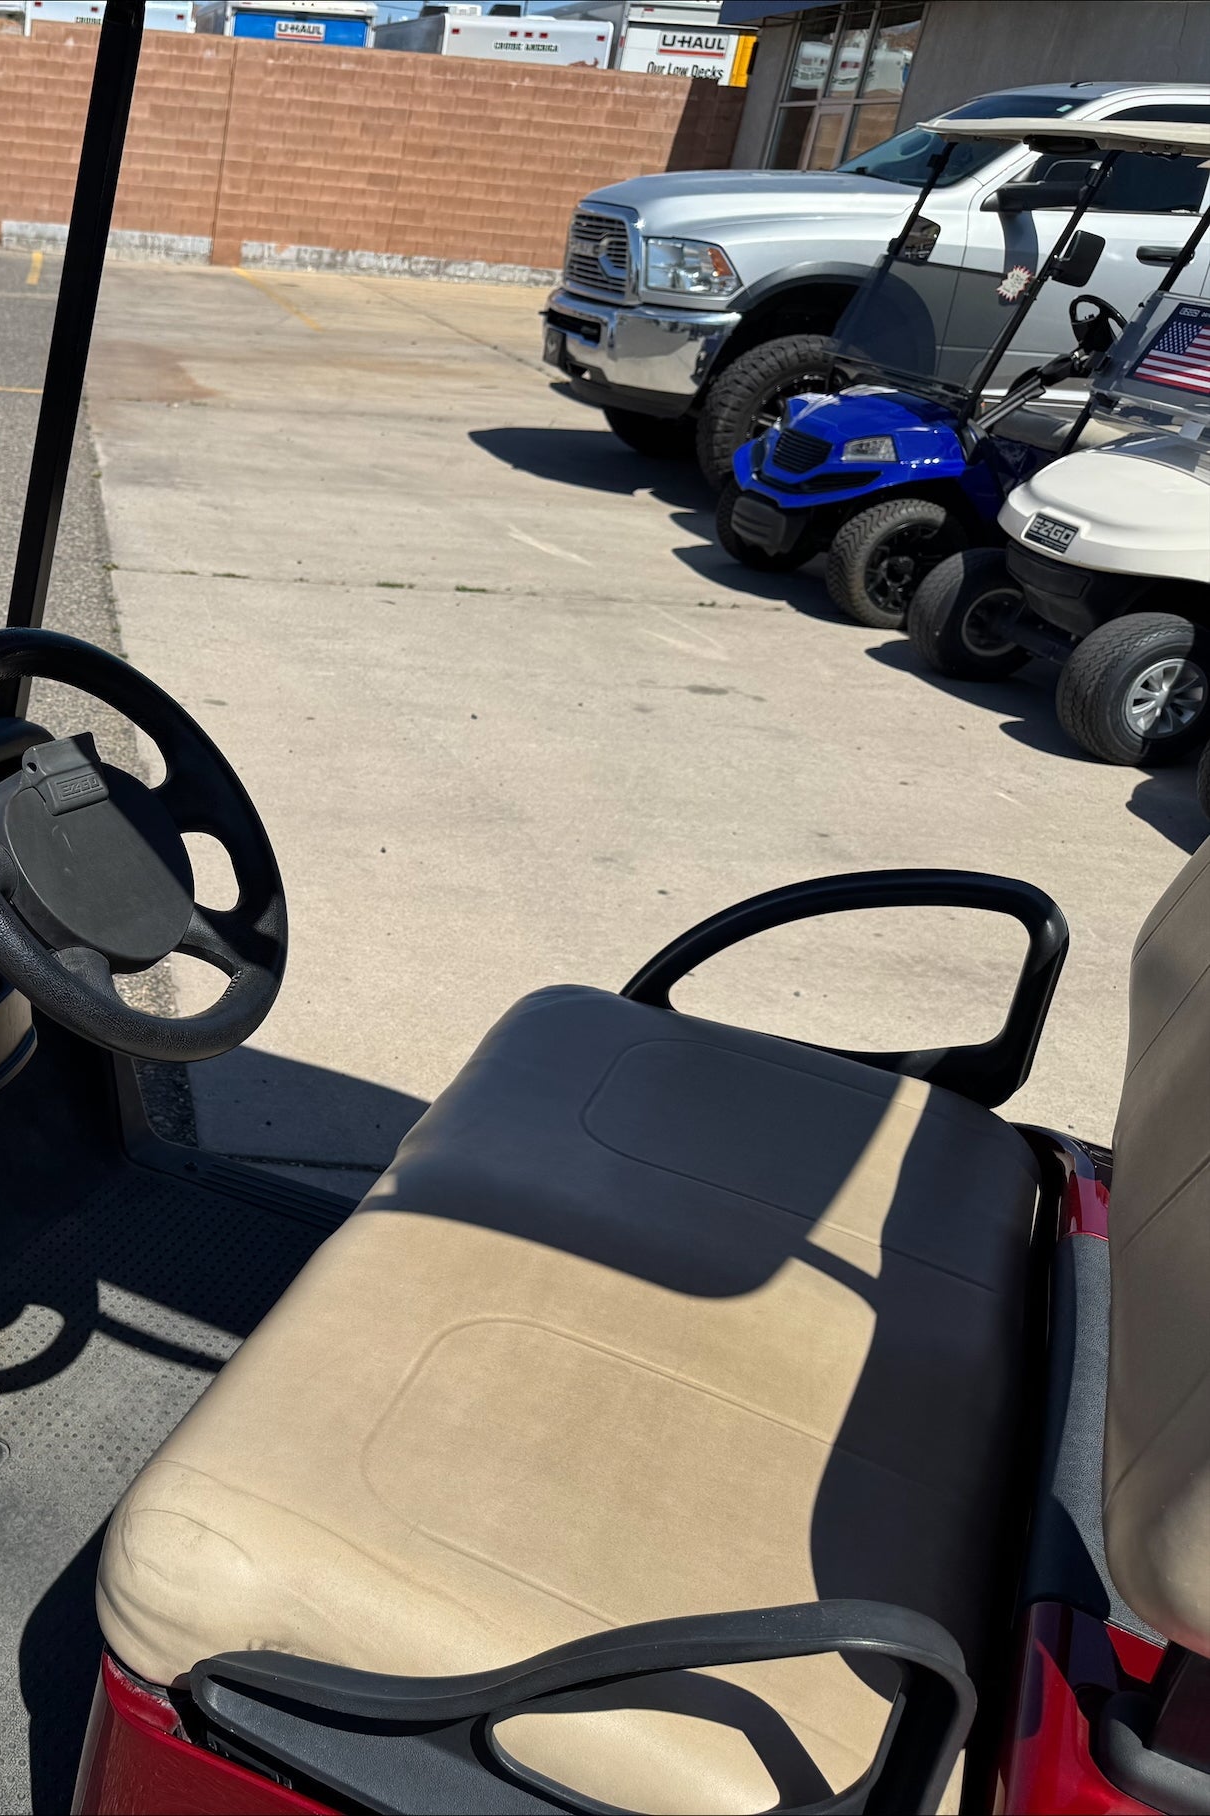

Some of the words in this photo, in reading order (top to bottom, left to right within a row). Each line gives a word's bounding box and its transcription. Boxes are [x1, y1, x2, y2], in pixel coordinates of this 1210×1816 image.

[277, 23, 322, 35] U-HAUL
[662, 34, 725, 50] U-HAUL
[691, 64, 724, 79] Decks
[1030, 518, 1076, 544] EZGO
